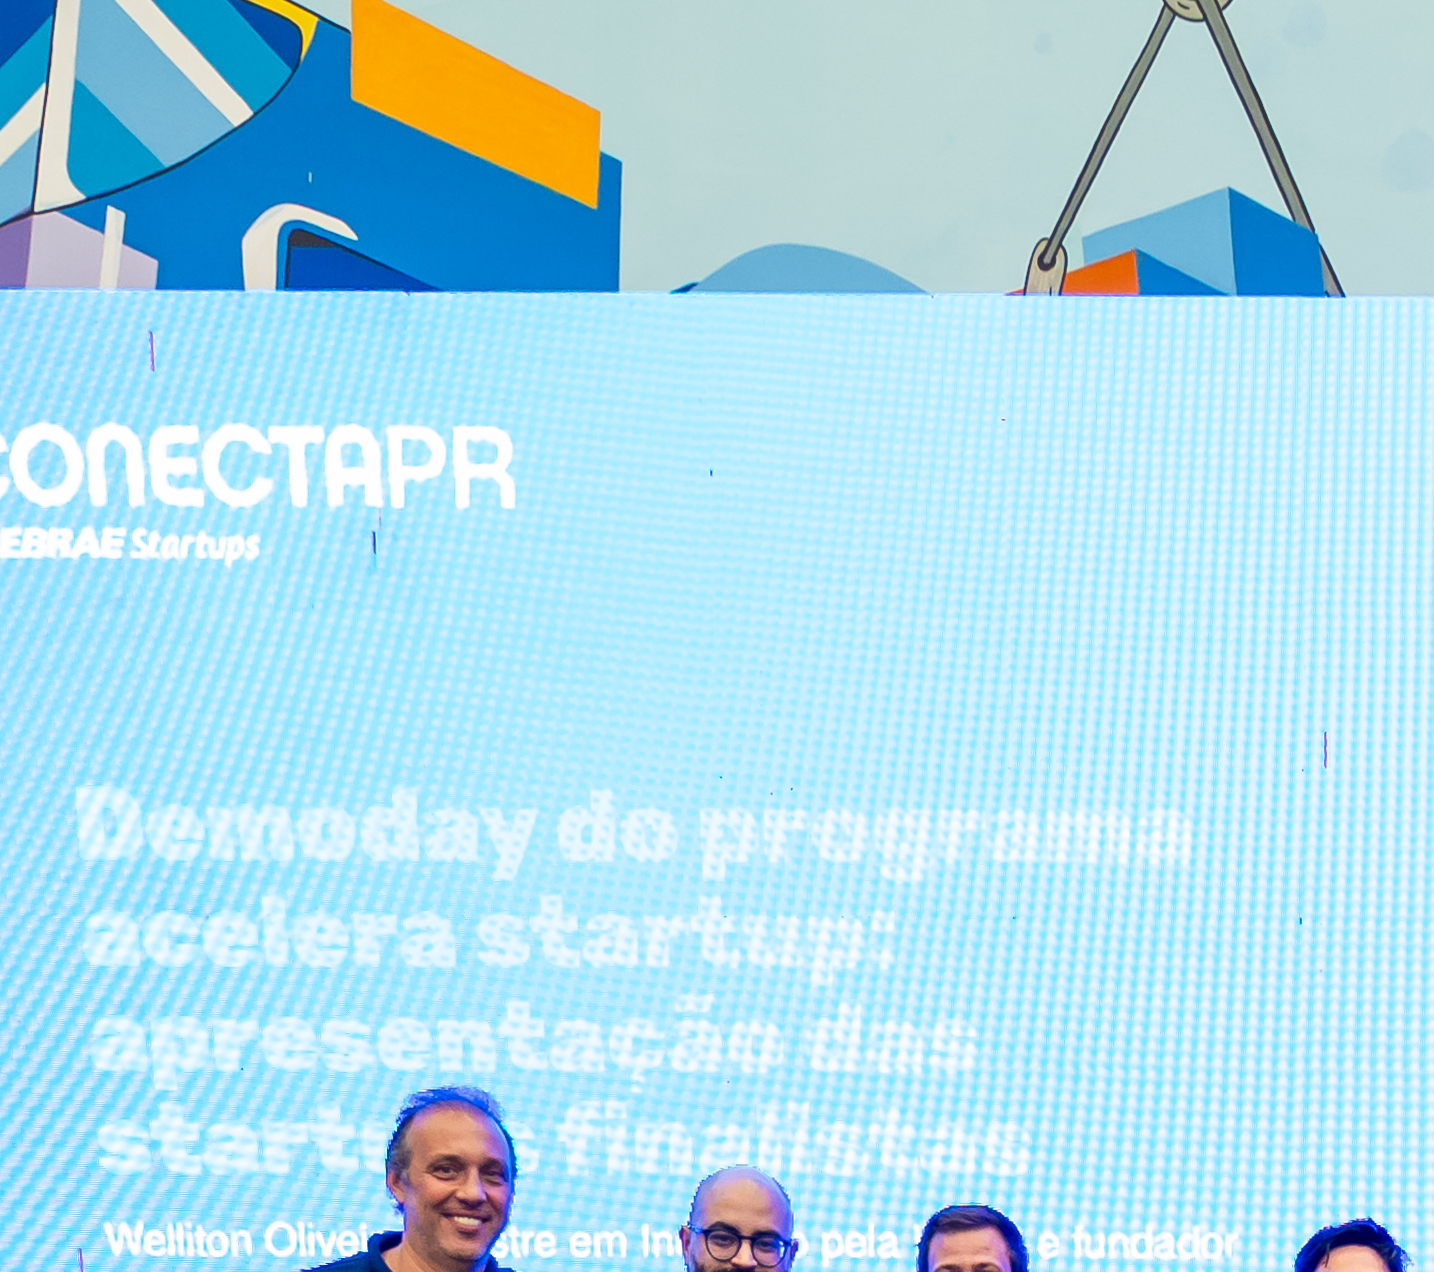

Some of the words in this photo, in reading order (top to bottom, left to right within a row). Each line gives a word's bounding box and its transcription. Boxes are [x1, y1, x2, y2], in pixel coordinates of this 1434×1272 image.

[131, 528, 260, 567] Startups
[76, 785, 538, 881] Demoday
[557, 788, 678, 862] do
[700, 808, 1193, 884] programa
[82, 895, 457, 968] acelera
[476, 895, 895, 987] startup:
[88, 993, 784, 1093] apresentação
[809, 1002, 979, 1074] das
[98, 1099, 540, 1175] starts
[560, 1100, 1033, 1177] finalistas
[103, 1221, 253, 1257] Welliton
[264, 1221, 367, 1258] Olivei
[491, 1225, 558, 1258] stre
[569, 1231, 627, 1258] em
[822, 1223, 900, 1268] pela
[1038, 1233, 1059, 1260] e
[1072, 1225, 1237, 1260] fundador
